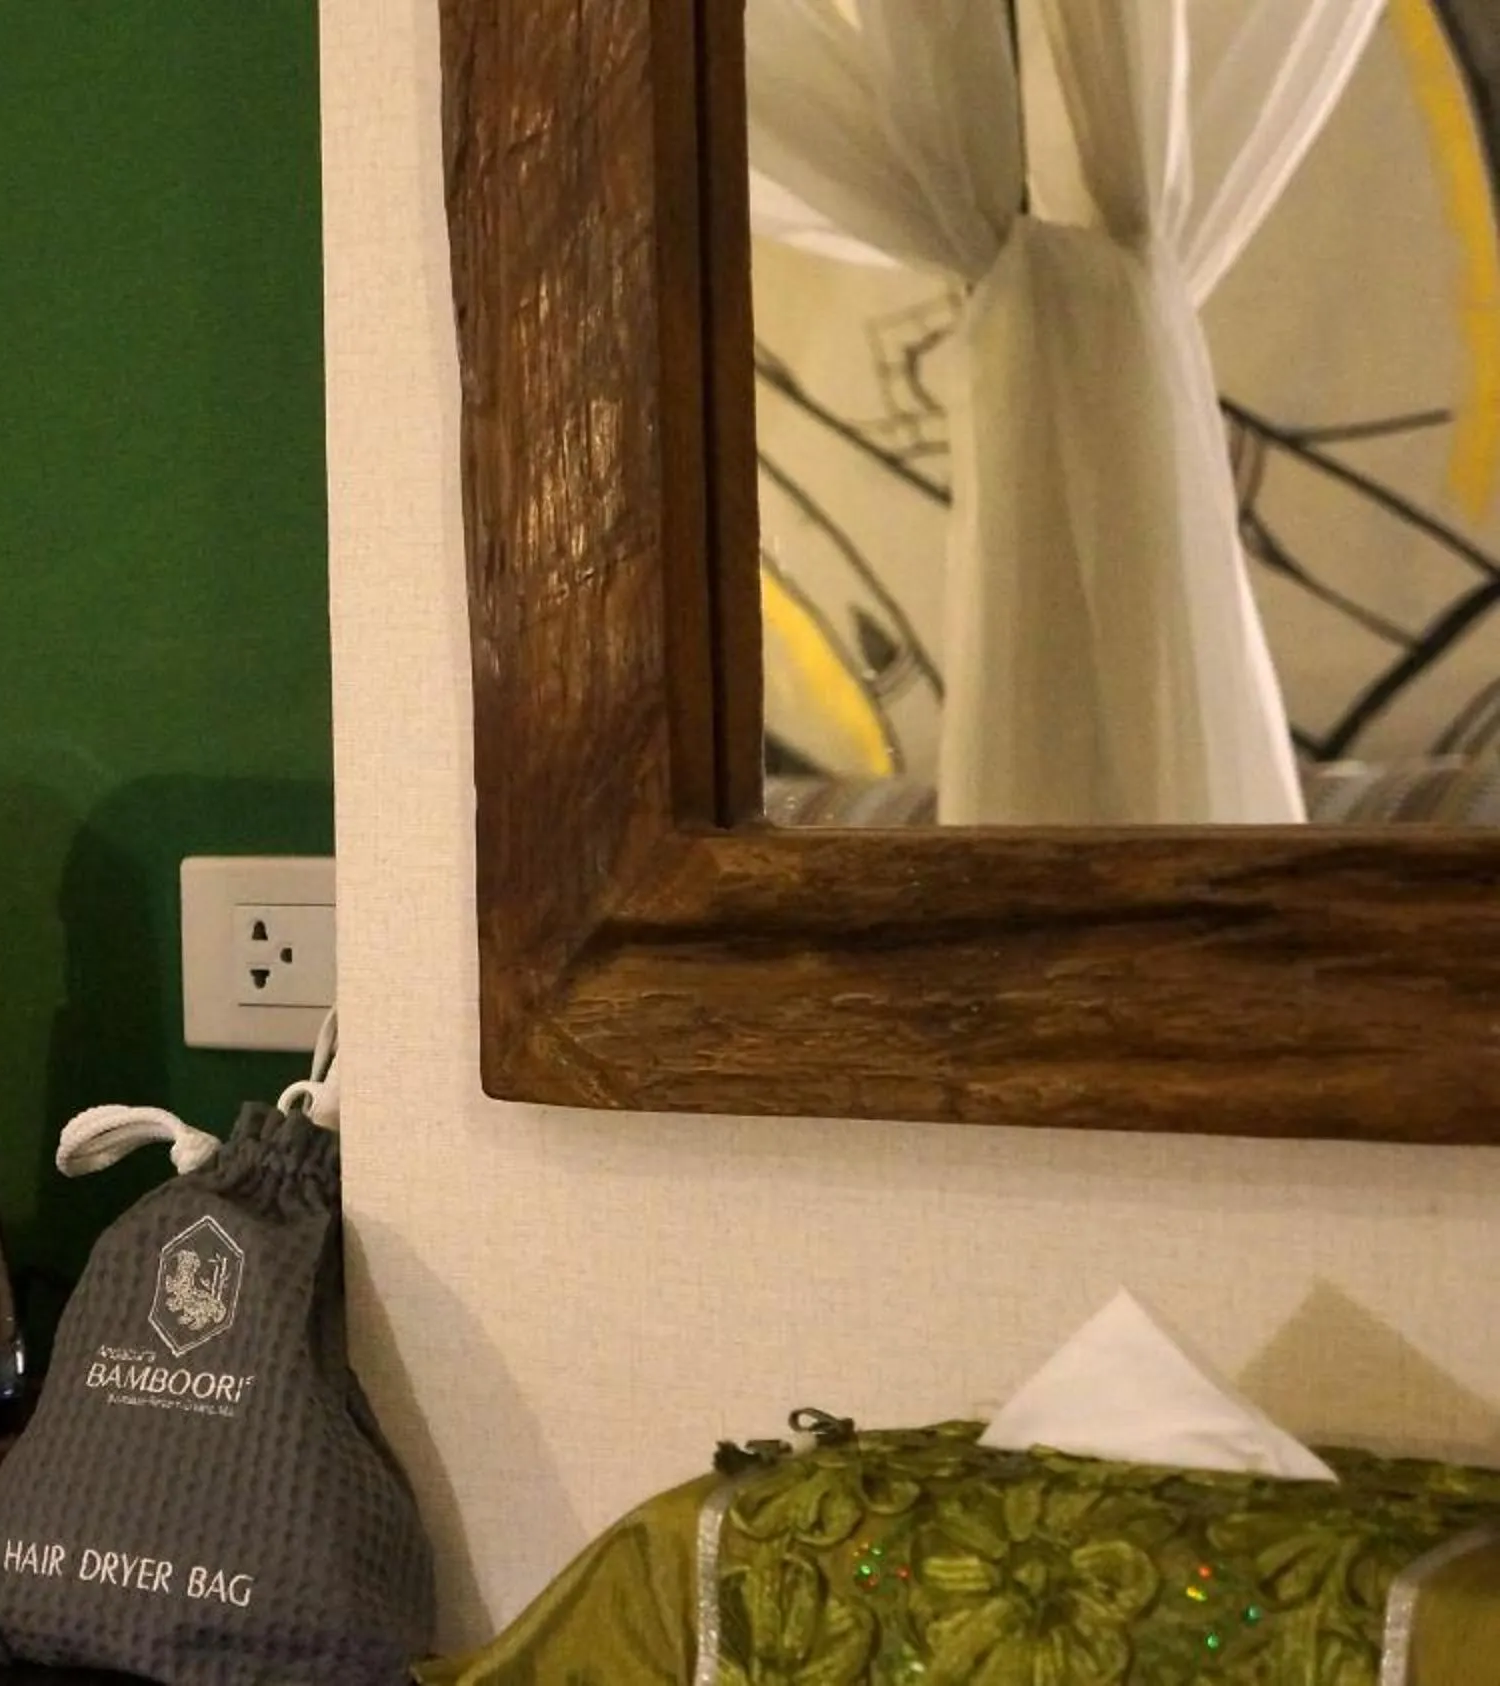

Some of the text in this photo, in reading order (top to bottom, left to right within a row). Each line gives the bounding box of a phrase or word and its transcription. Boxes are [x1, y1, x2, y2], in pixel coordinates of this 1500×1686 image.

[3, 1538, 254, 1607] HAIR DRYER BAG
